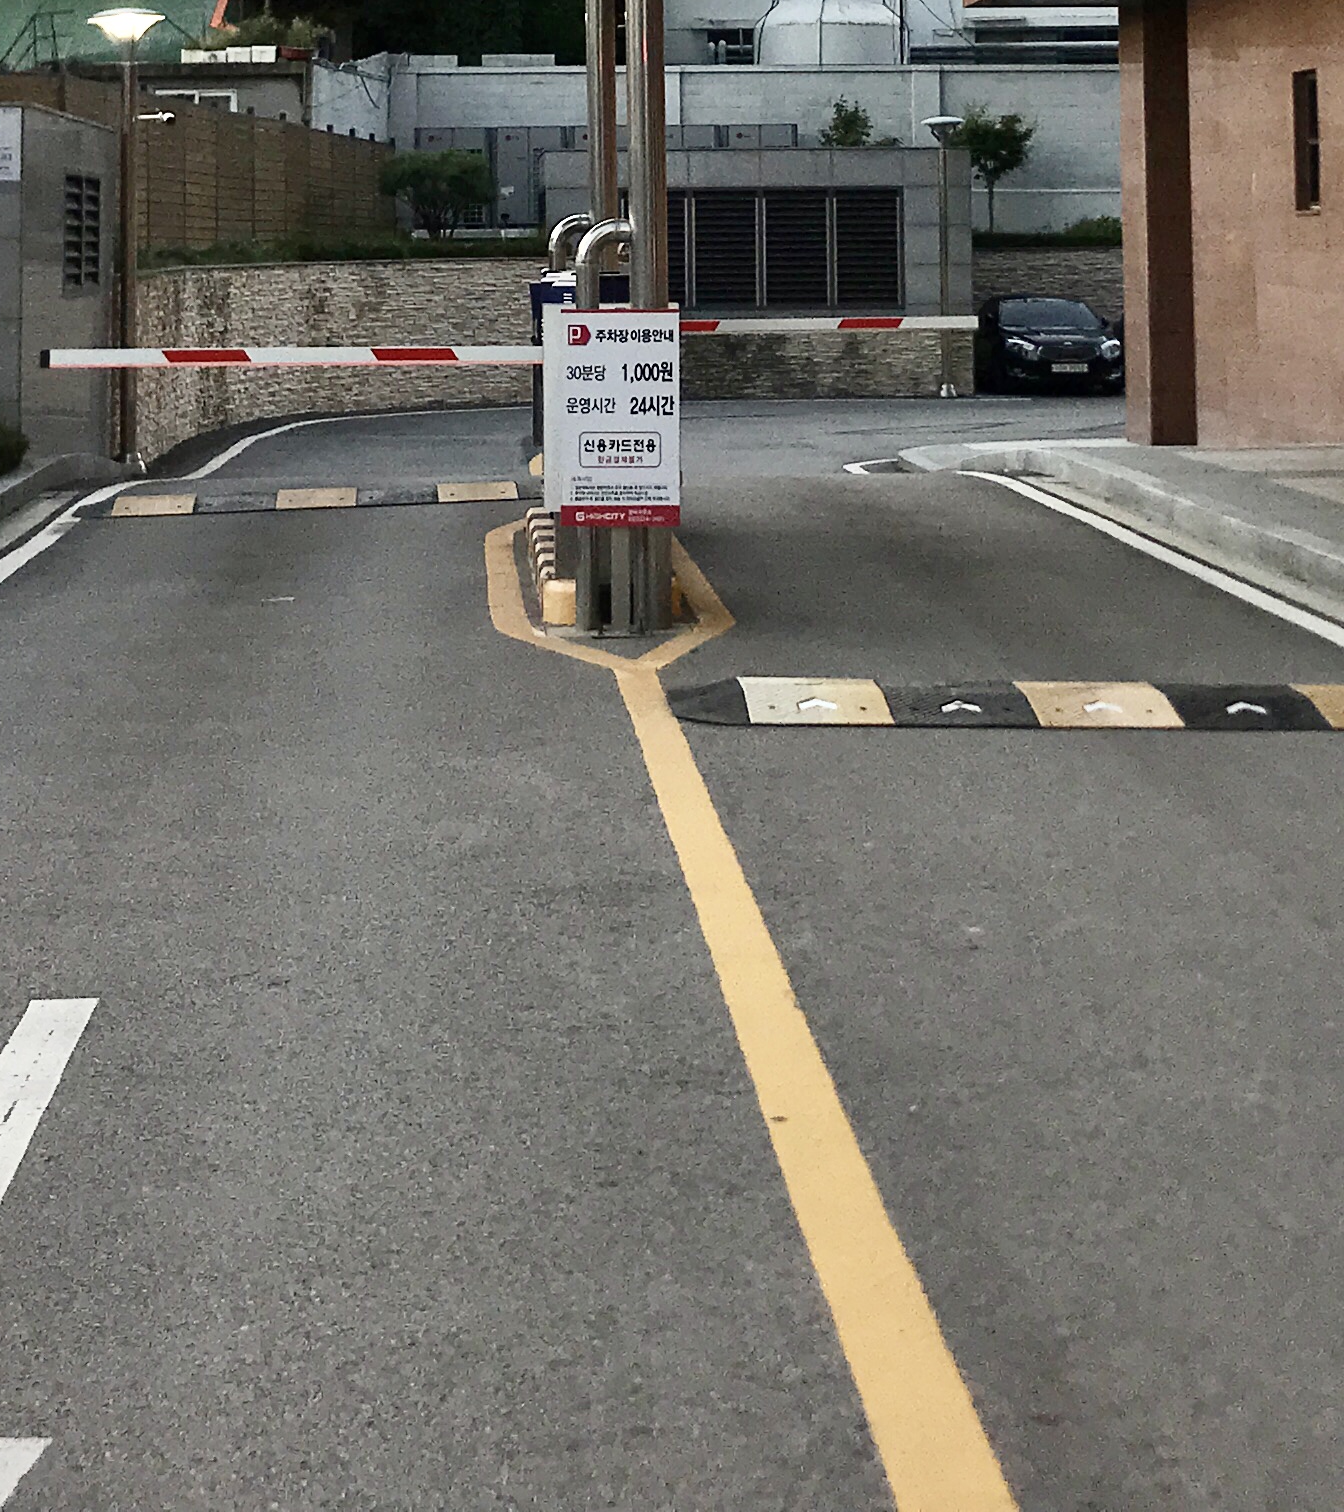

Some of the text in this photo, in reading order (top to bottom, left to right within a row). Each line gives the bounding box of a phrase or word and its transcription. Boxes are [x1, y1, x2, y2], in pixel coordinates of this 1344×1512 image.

[566, 362, 674, 383] 30분당 1,000원
[566, 395, 675, 416] 운영시간 24시간
